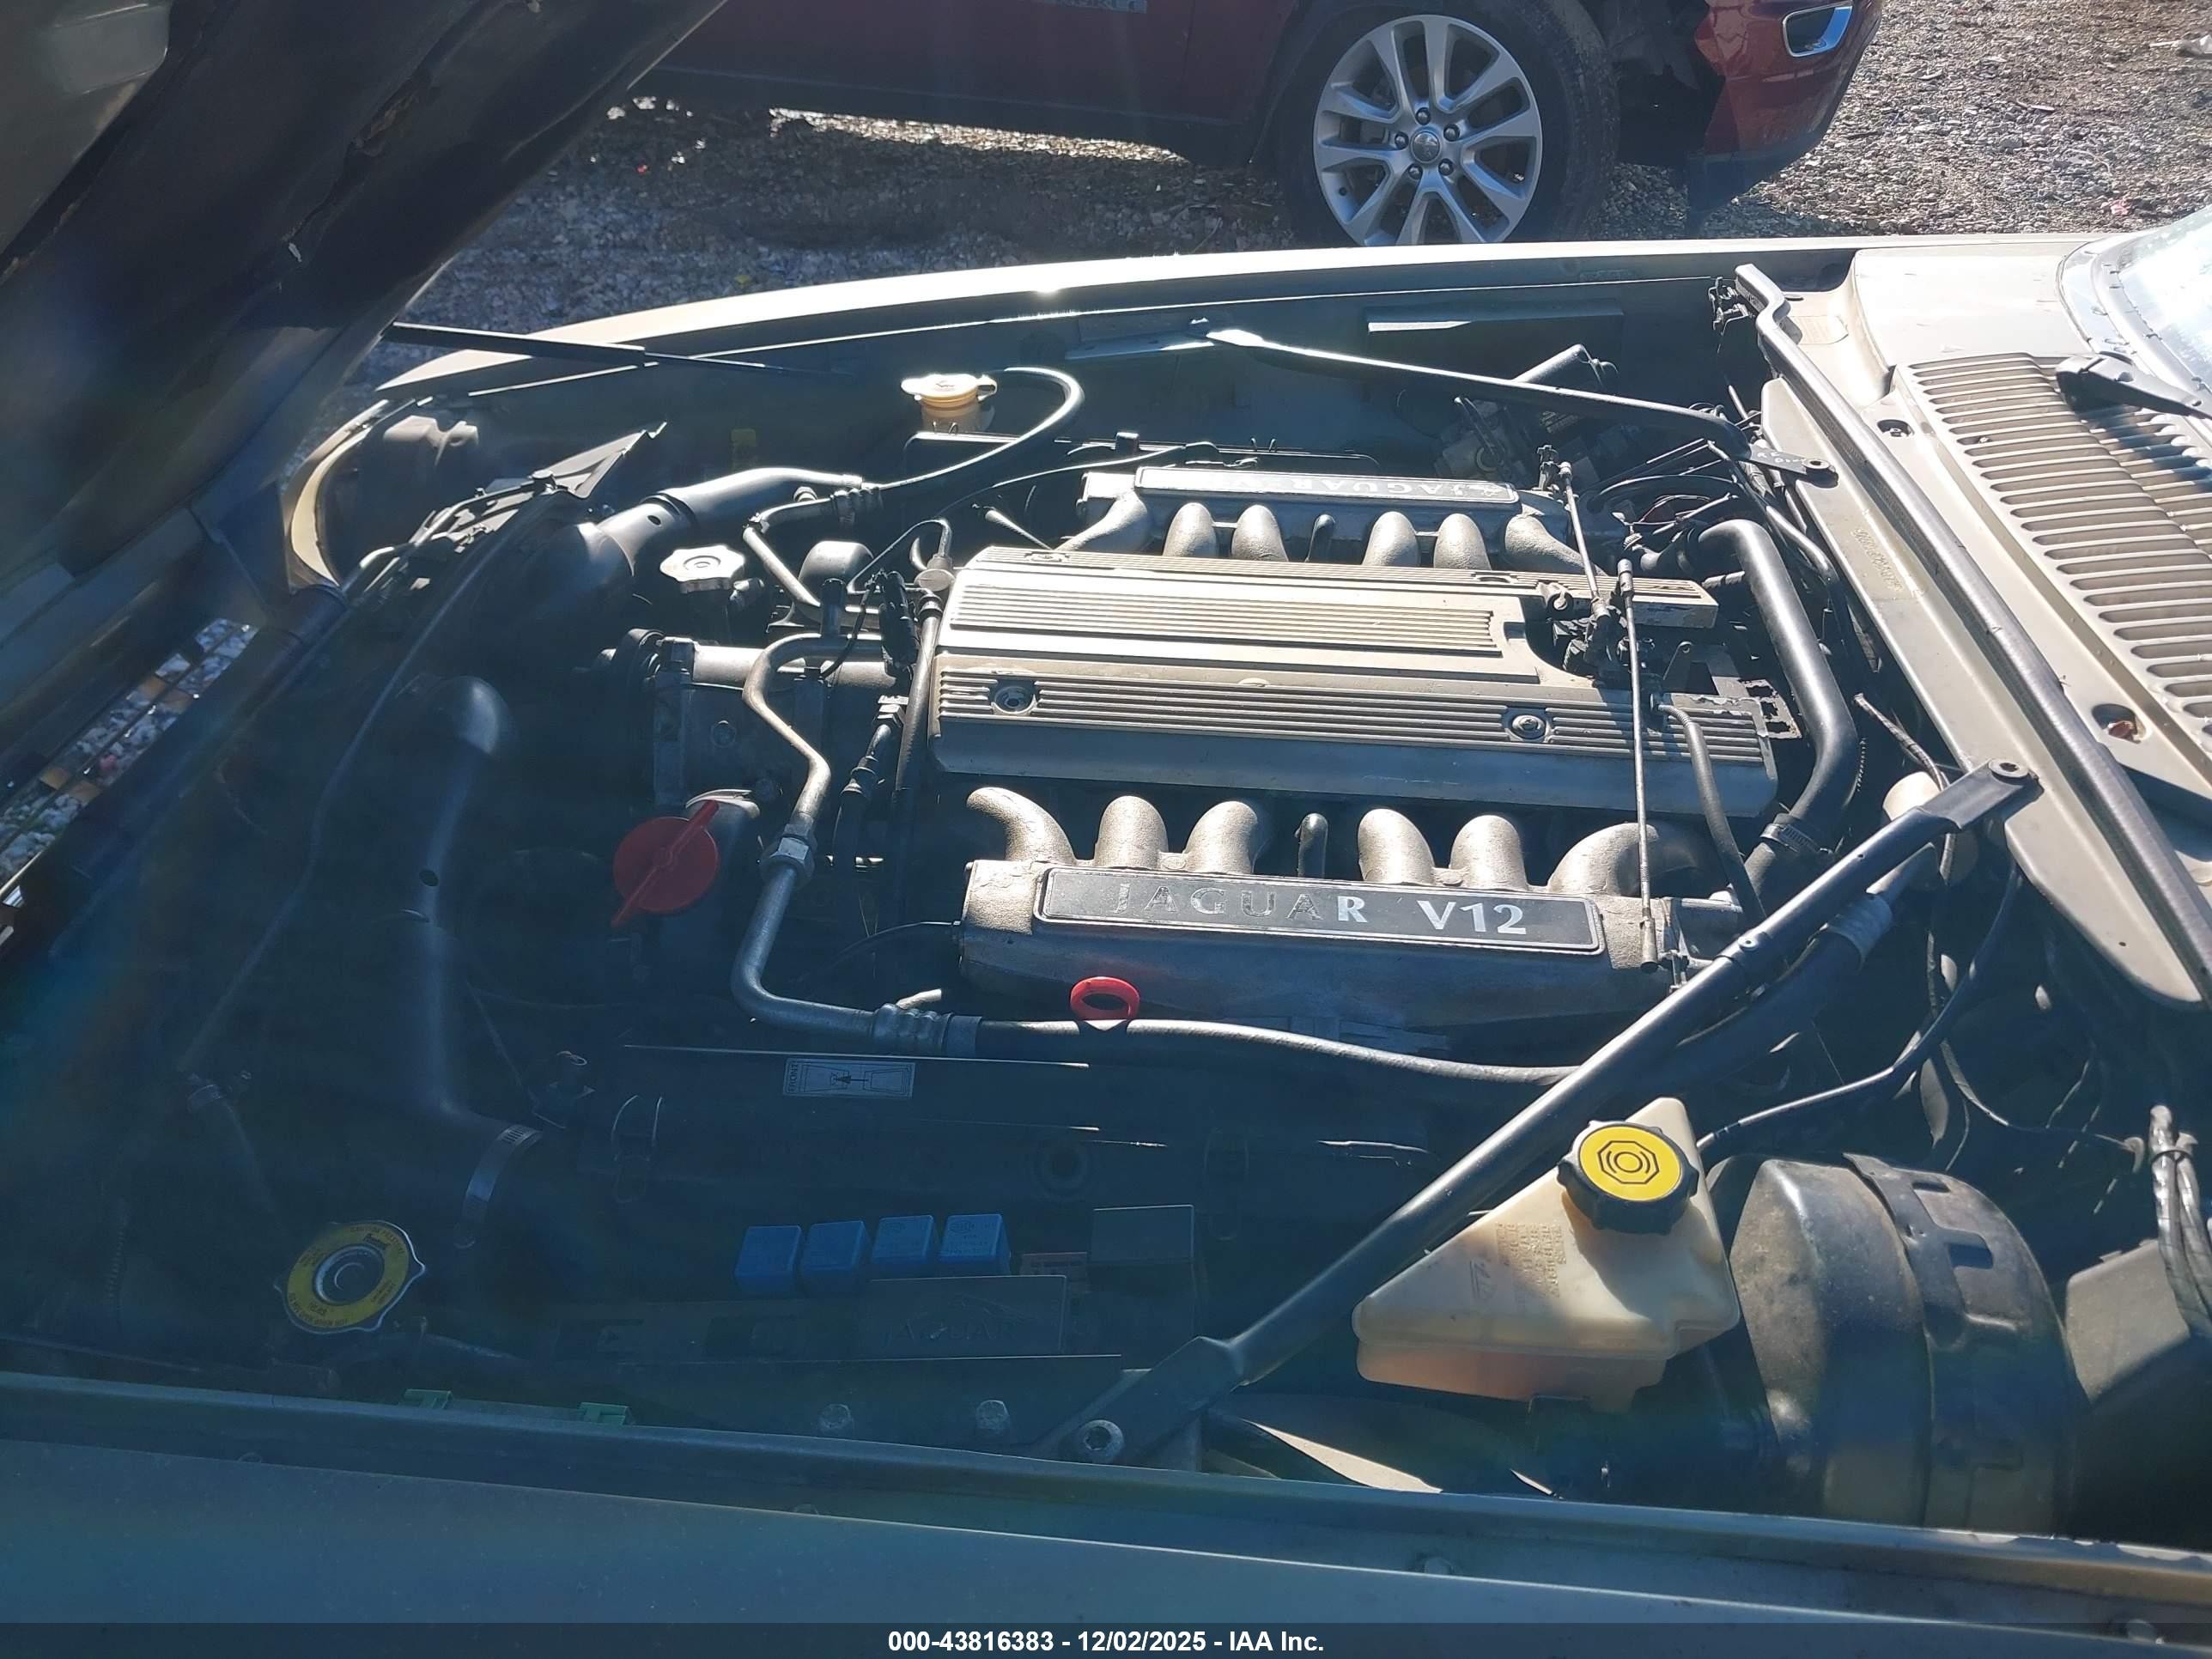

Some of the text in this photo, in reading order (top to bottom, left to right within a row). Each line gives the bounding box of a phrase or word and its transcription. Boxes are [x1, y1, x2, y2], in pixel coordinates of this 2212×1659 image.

[1291, 479, 1467, 498] JAGUAR
[1114, 883, 1528, 936] JAGUAR V12
